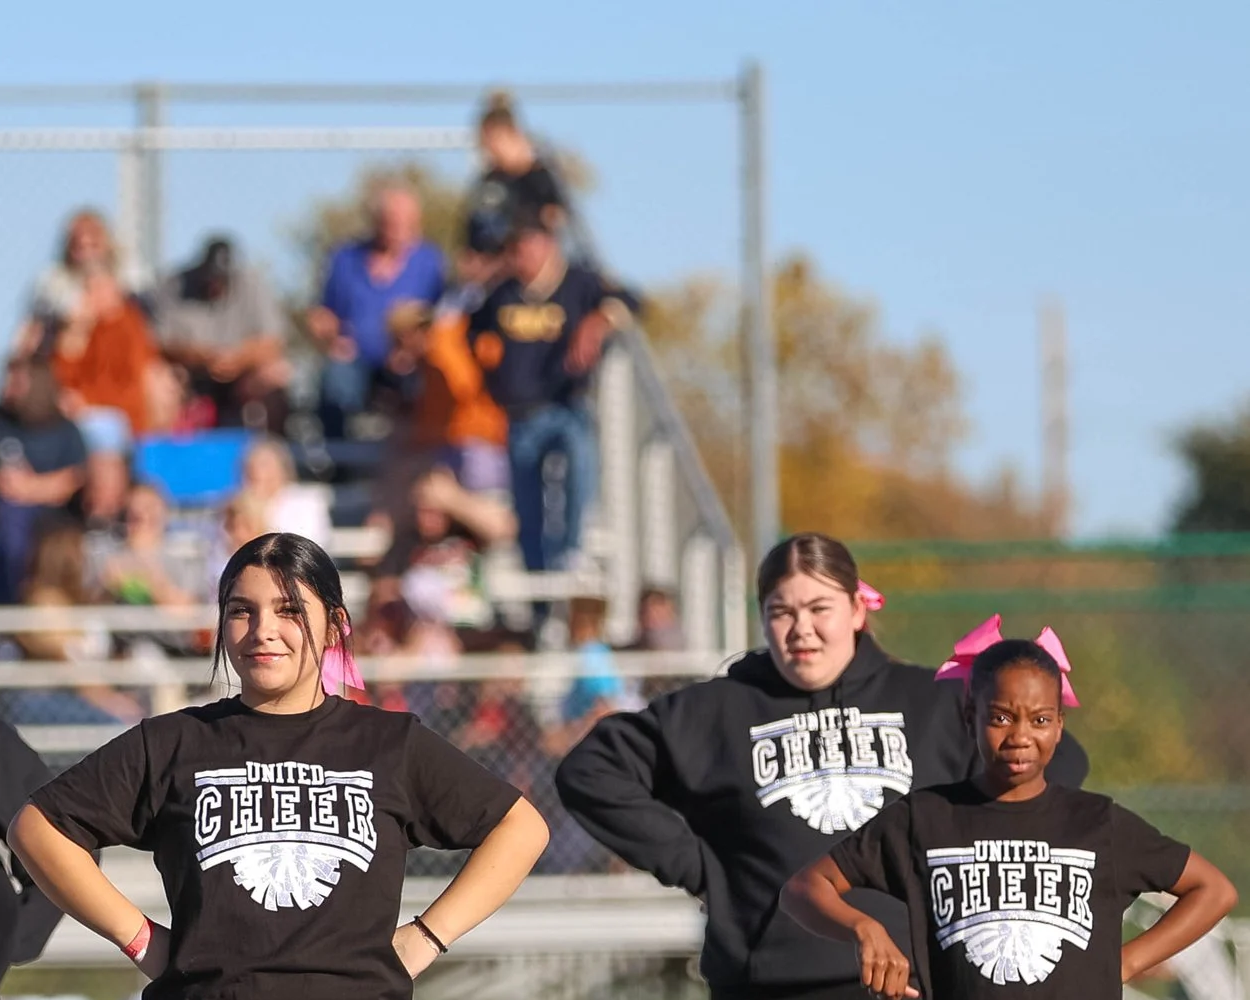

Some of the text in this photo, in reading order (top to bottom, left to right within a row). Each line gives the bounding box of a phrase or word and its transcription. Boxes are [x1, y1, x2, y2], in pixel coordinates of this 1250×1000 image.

[246, 761, 324, 786] UNITED
[752, 726, 913, 787] CHEER
[194, 785, 377, 851] CHEER
[974, 840, 1050, 863] UNITED
[930, 862, 1093, 930] CHEER
